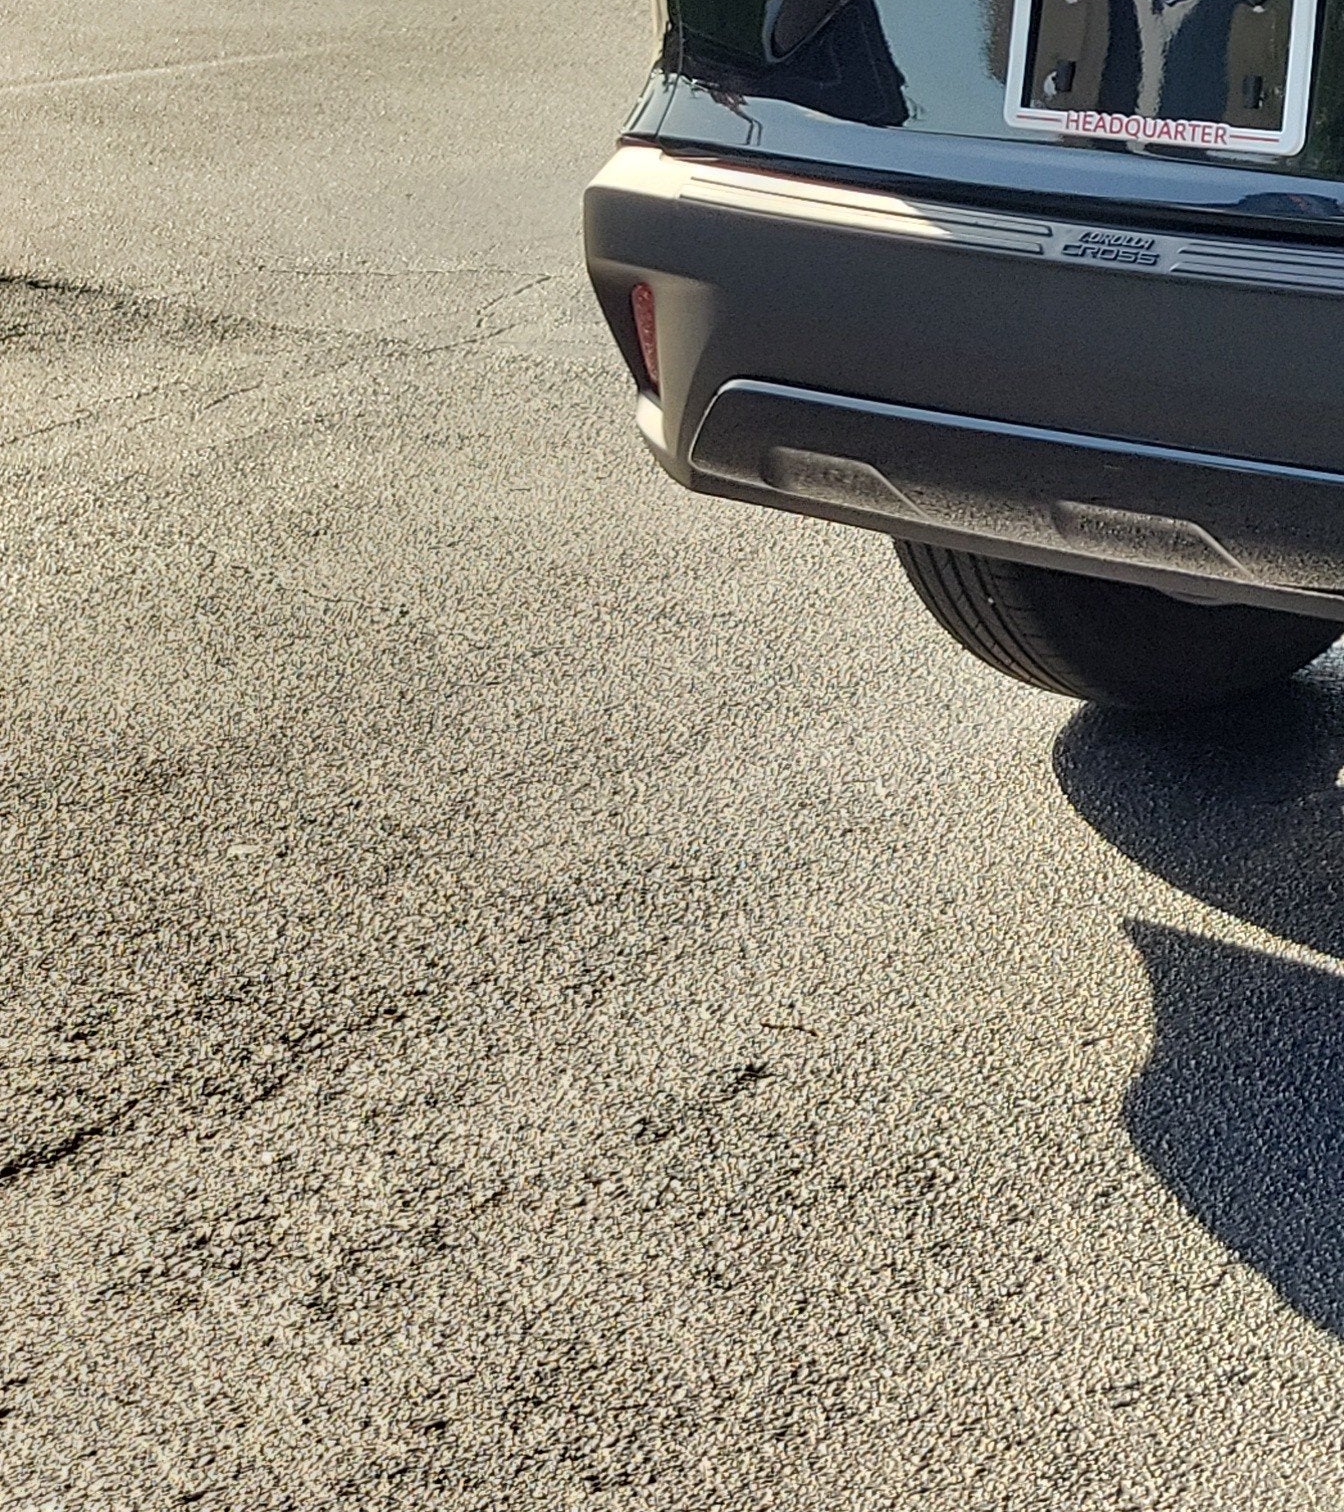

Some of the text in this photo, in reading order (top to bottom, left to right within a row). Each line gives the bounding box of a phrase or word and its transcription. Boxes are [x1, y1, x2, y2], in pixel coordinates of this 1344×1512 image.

[1065, 110, 1228, 146] HEADQUARTER
[1079, 231, 1155, 251] COROLLA
[1062, 244, 1160, 267] CROSS
